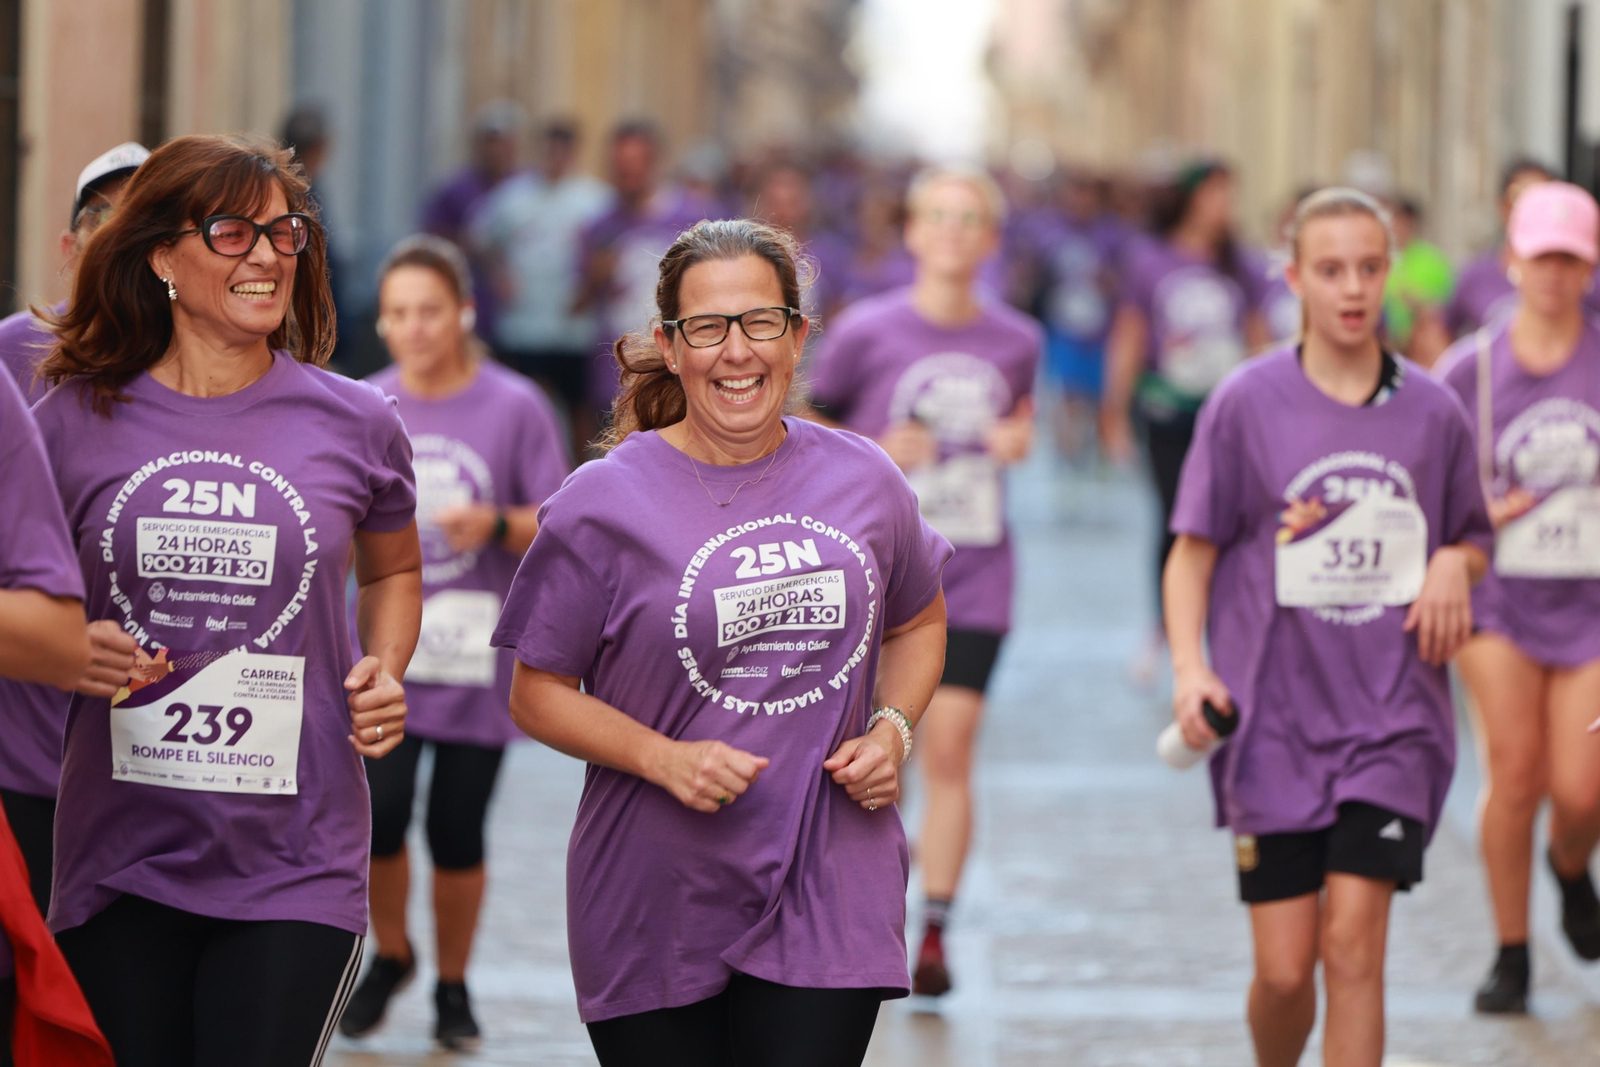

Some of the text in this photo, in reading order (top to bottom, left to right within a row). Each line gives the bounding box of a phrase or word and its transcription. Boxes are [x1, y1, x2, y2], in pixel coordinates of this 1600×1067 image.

[107, 450, 245, 523] INTERNACIONAL
[162, 478, 257, 518] 25N
[249, 461, 310, 526] CONTRA
[99, 527, 115, 562] DÍA
[142, 522, 271, 539] SERVICIO DE EMERGENCIAS
[157, 535, 252, 556] 24 HORAS
[303, 527, 319, 555] LA
[801, 515, 866, 567] CONTRA
[143, 554, 264, 578] 900 21 21 30
[678, 513, 797, 598] INTERNACIONAL
[729, 538, 822, 579] 25N
[1323, 538, 1382, 569] 351
[167, 588, 219, 603] Ayuntamiento
[220, 593, 231, 605] de
[720, 575, 840, 601] SERVICIO DE EMERGENCIAS
[865, 568, 876, 596] LA
[253, 559, 318, 649] VIOLENCIA
[736, 587, 824, 617] 24 HORAS
[671, 602, 689, 638] DÍA
[724, 607, 837, 640] 900 21 21 30
[740, 640, 830, 655] Ayuntamiento de Cádiz
[241, 668, 297, 681] CARRERA
[722, 695, 760, 716] LAS
[763, 687, 824, 716] HACIA
[160, 702, 253, 746] 239
[131, 744, 275, 768] ROMPE EL SILENCIO
